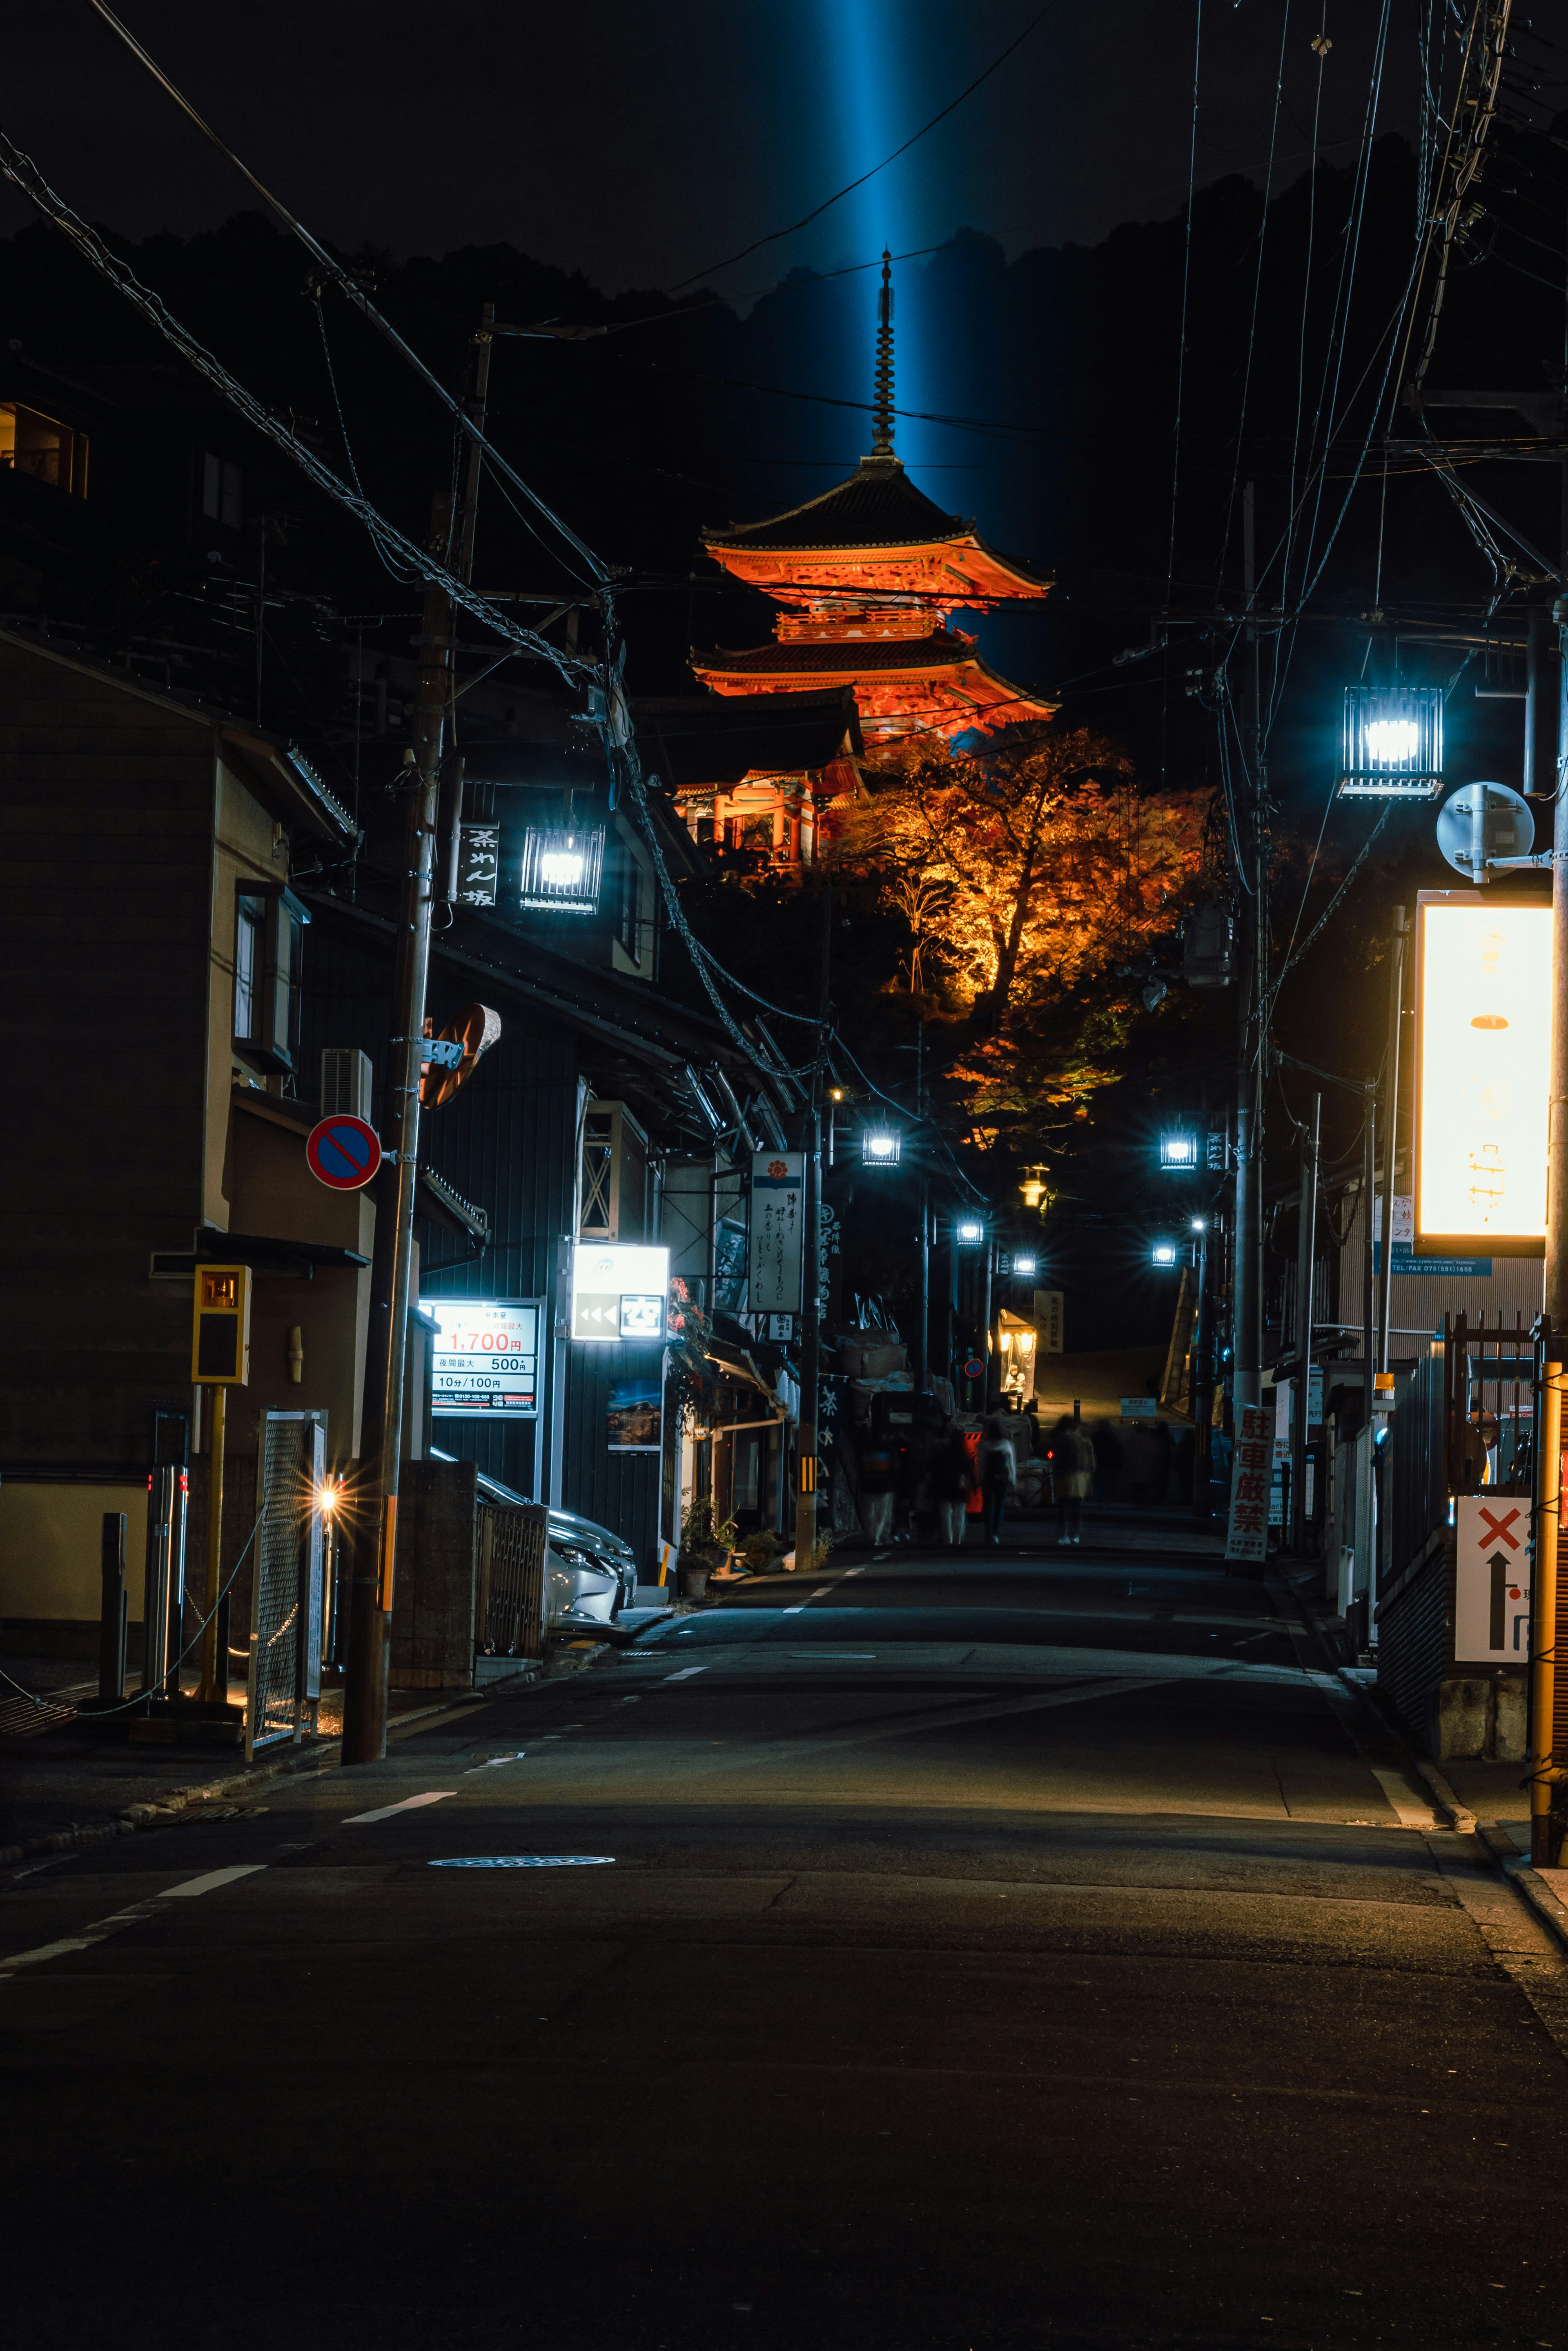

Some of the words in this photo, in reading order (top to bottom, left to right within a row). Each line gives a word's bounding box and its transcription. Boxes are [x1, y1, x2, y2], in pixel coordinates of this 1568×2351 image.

[450, 1333, 521, 1352] 1,700円
[439, 1359, 474, 1367] 夜間最大
[439, 1377, 500, 1388] 10分/100円
[1233, 1409, 1270, 1534] 駐車厳禁
